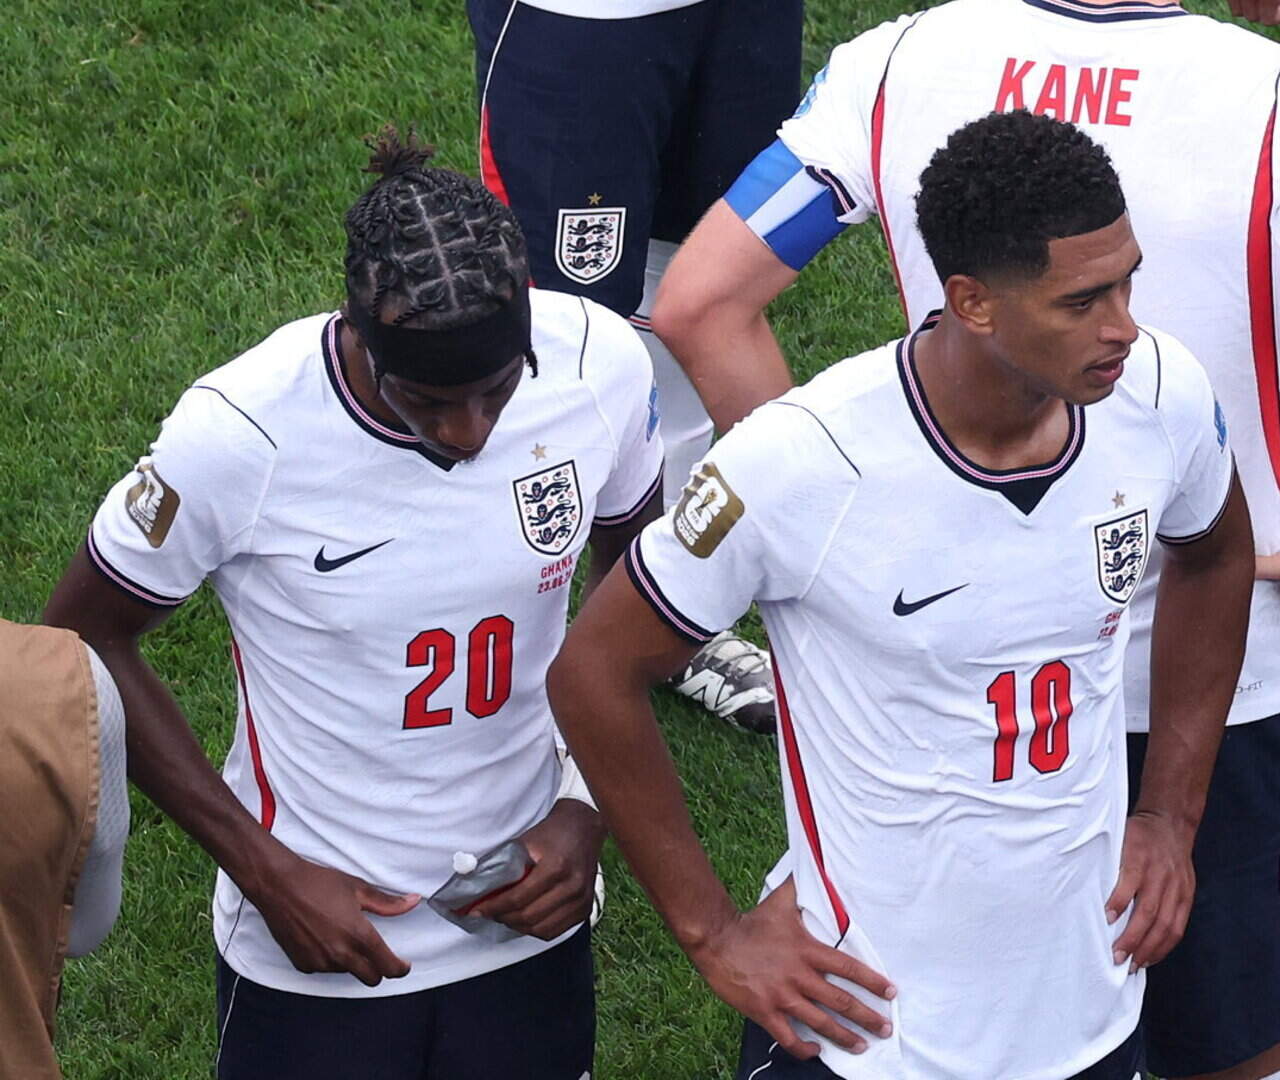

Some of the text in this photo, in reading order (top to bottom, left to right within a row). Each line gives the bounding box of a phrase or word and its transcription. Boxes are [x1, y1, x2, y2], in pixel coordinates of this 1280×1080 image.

[995, 57, 1140, 127] KANE
[402, 614, 514, 730] 20
[986, 659, 1074, 783] 10
